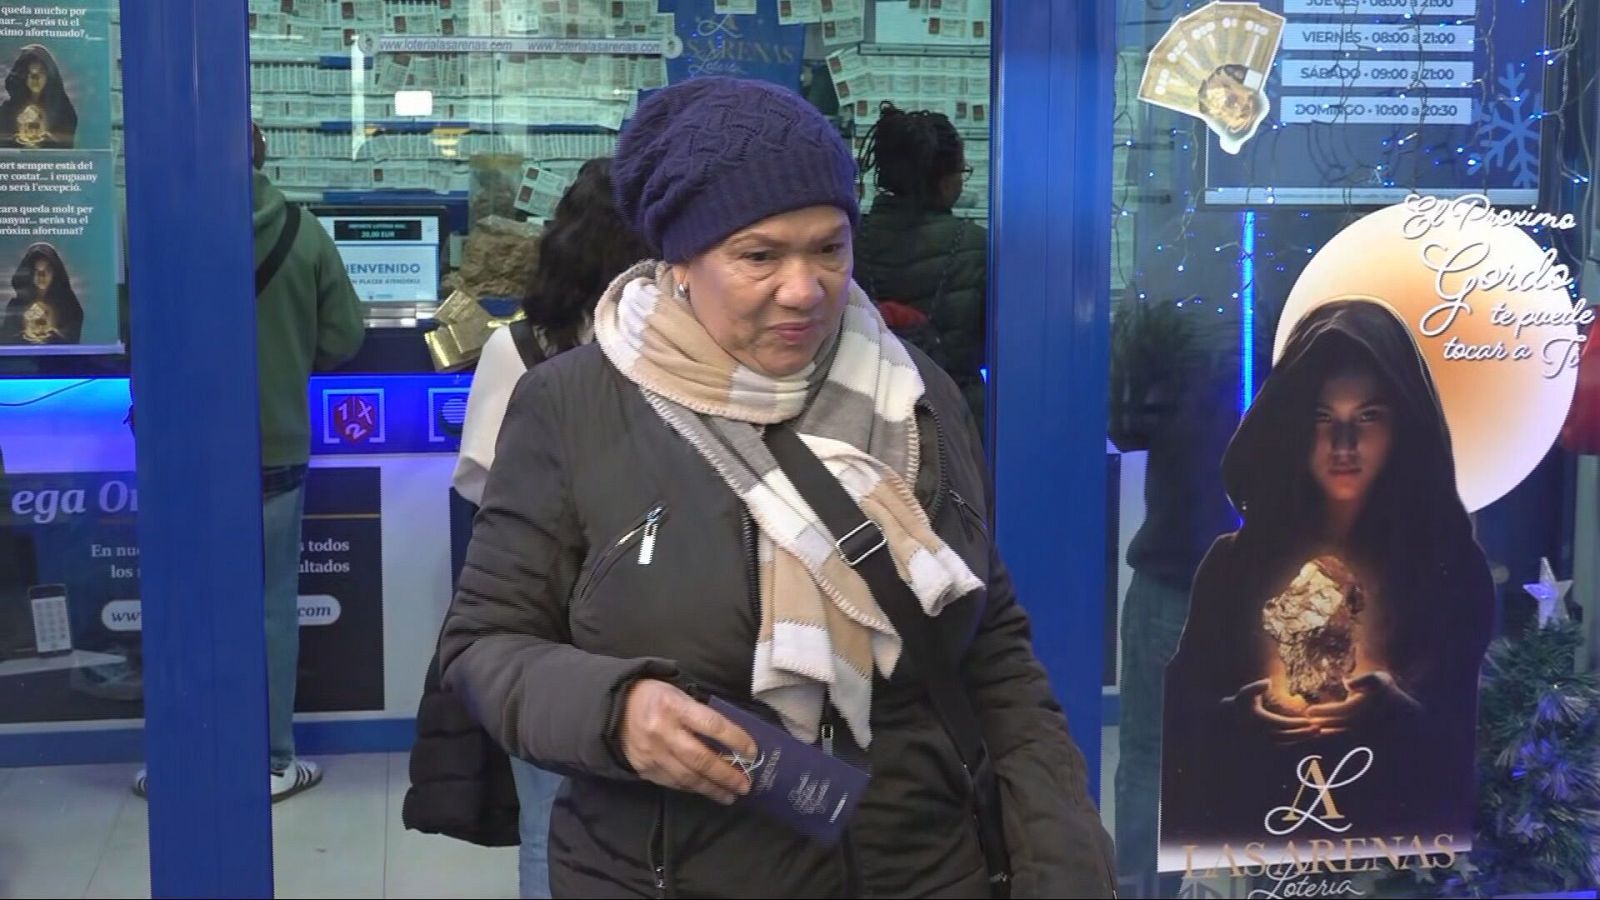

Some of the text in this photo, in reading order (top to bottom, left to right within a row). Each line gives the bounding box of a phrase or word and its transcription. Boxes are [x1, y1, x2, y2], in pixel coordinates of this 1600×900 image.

[1, 6, 86, 17] queda mucho por
[70, 18, 80, 26] el
[1302, 31, 1362, 43] VIERNES
[1372, 32, 1409, 44] 08:00
[1422, 33, 1455, 44] 21:00
[1300, 65, 1361, 80] SÁBADO
[1371, 68, 1408, 80] 09:00
[1422, 68, 1454, 80] 21:00
[1295, 103, 1457, 116] DOMINGO 10:00 a 20:30
[17, 162, 54, 171] sempre
[78, 161, 93, 170] del
[50, 172, 54, 181] i
[56, 173, 97, 183] enguany
[20, 204, 50, 215] queda
[52, 204, 75, 213] molt
[77, 206, 94, 215] per
[1403, 193, 1576, 239] El Proximo
[67, 216, 77, 224] tu
[79, 215, 88, 224] el
[32, 226, 84, 235] afortunat?
[1420, 242, 1573, 337] Gordo
[1490, 298, 1596, 339] te puede
[1443, 334, 1587, 379] tocar a Ti
[11, 488, 87, 524] ega
[91, 544, 112, 558] En
[308, 538, 350, 552] todos
[111, 564, 133, 579] los
[1181, 833, 1456, 880] LAS ARENAS
